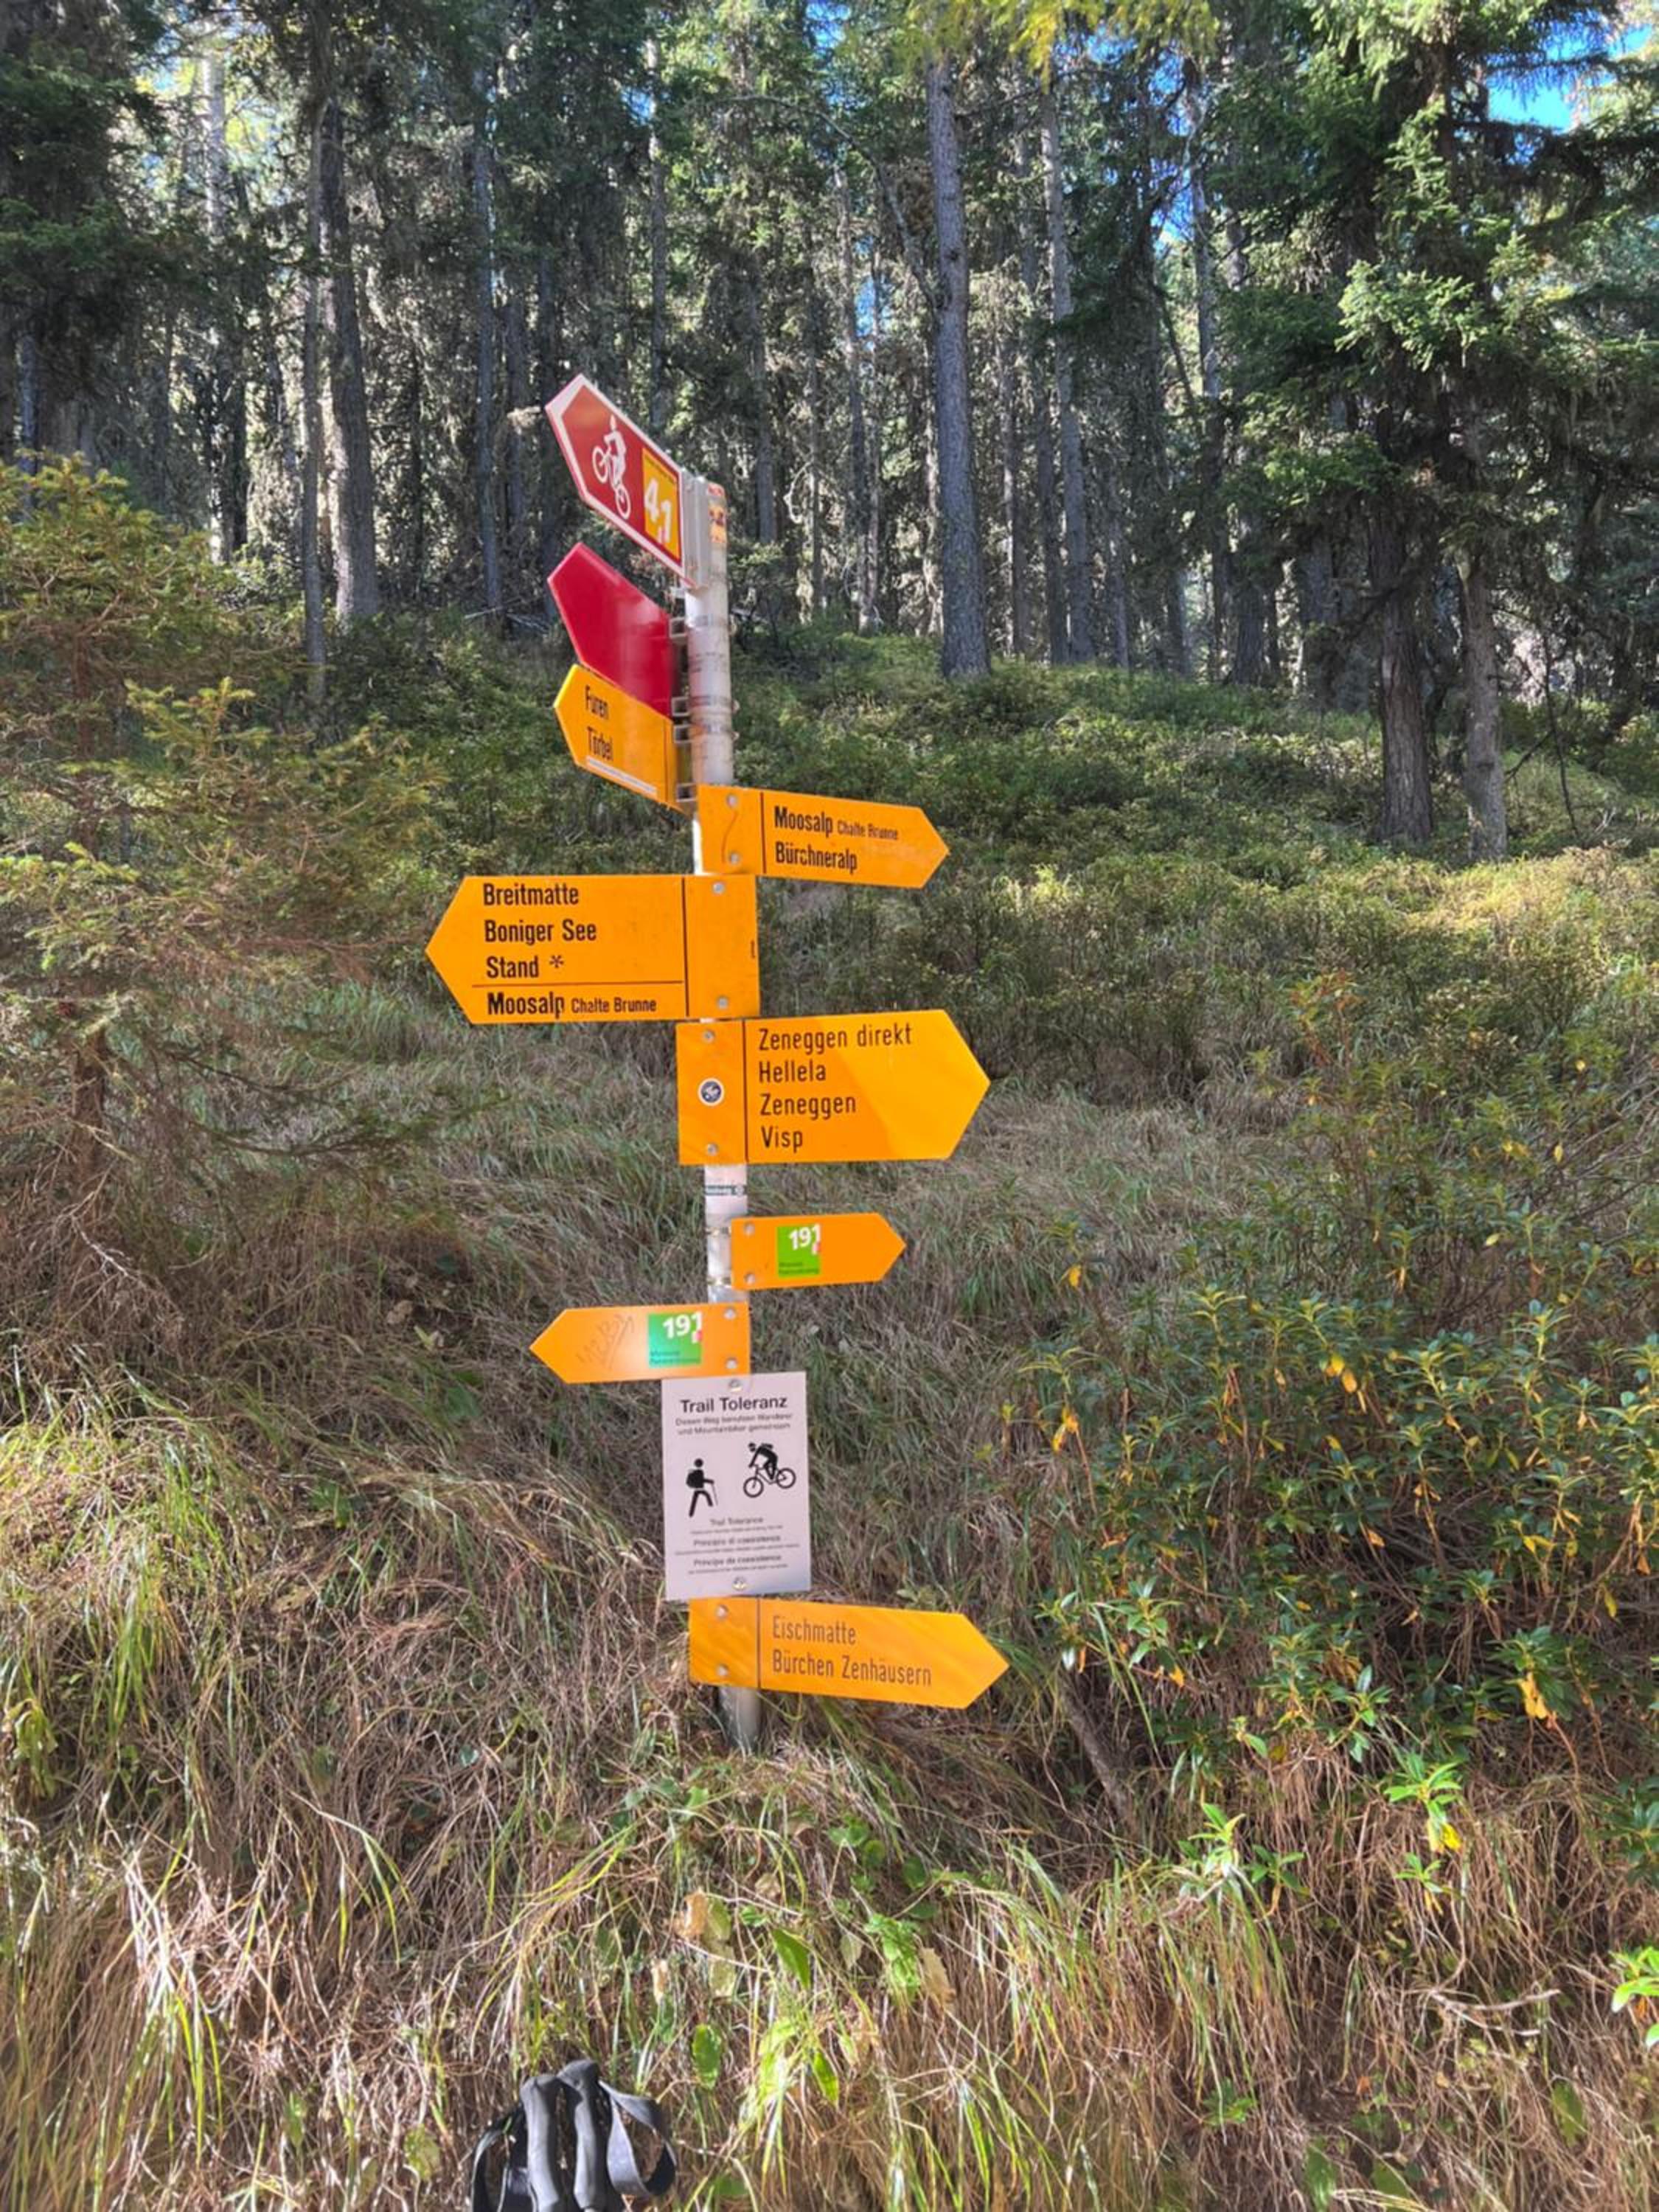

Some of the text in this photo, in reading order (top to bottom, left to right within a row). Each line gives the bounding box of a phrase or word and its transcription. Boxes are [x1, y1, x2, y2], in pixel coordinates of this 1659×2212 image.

[644, 477, 672, 543] 41
[774, 805, 833, 838] Moosalp
[775, 841, 858, 874] Bürchneralp
[483, 883, 580, 906] Breitmatte
[484, 918, 597, 946] Boniger See
[486, 955, 540, 979] Stand
[487, 991, 656, 1020] Moosalp Chalte Brunne
[759, 1023, 913, 1056] Zeneggen direkt
[759, 1059, 827, 1083] Hellela
[759, 1093, 856, 1121] Zeneggen
[760, 1125, 804, 1153] Visp
[788, 1222, 822, 1251] 191
[662, 1311, 703, 1340] 191
[680, 1396, 788, 1413] Trail Toleranz
[772, 1615, 857, 1645] Eischmatte
[772, 1649, 932, 1687] Bürchen Zenhäusern
